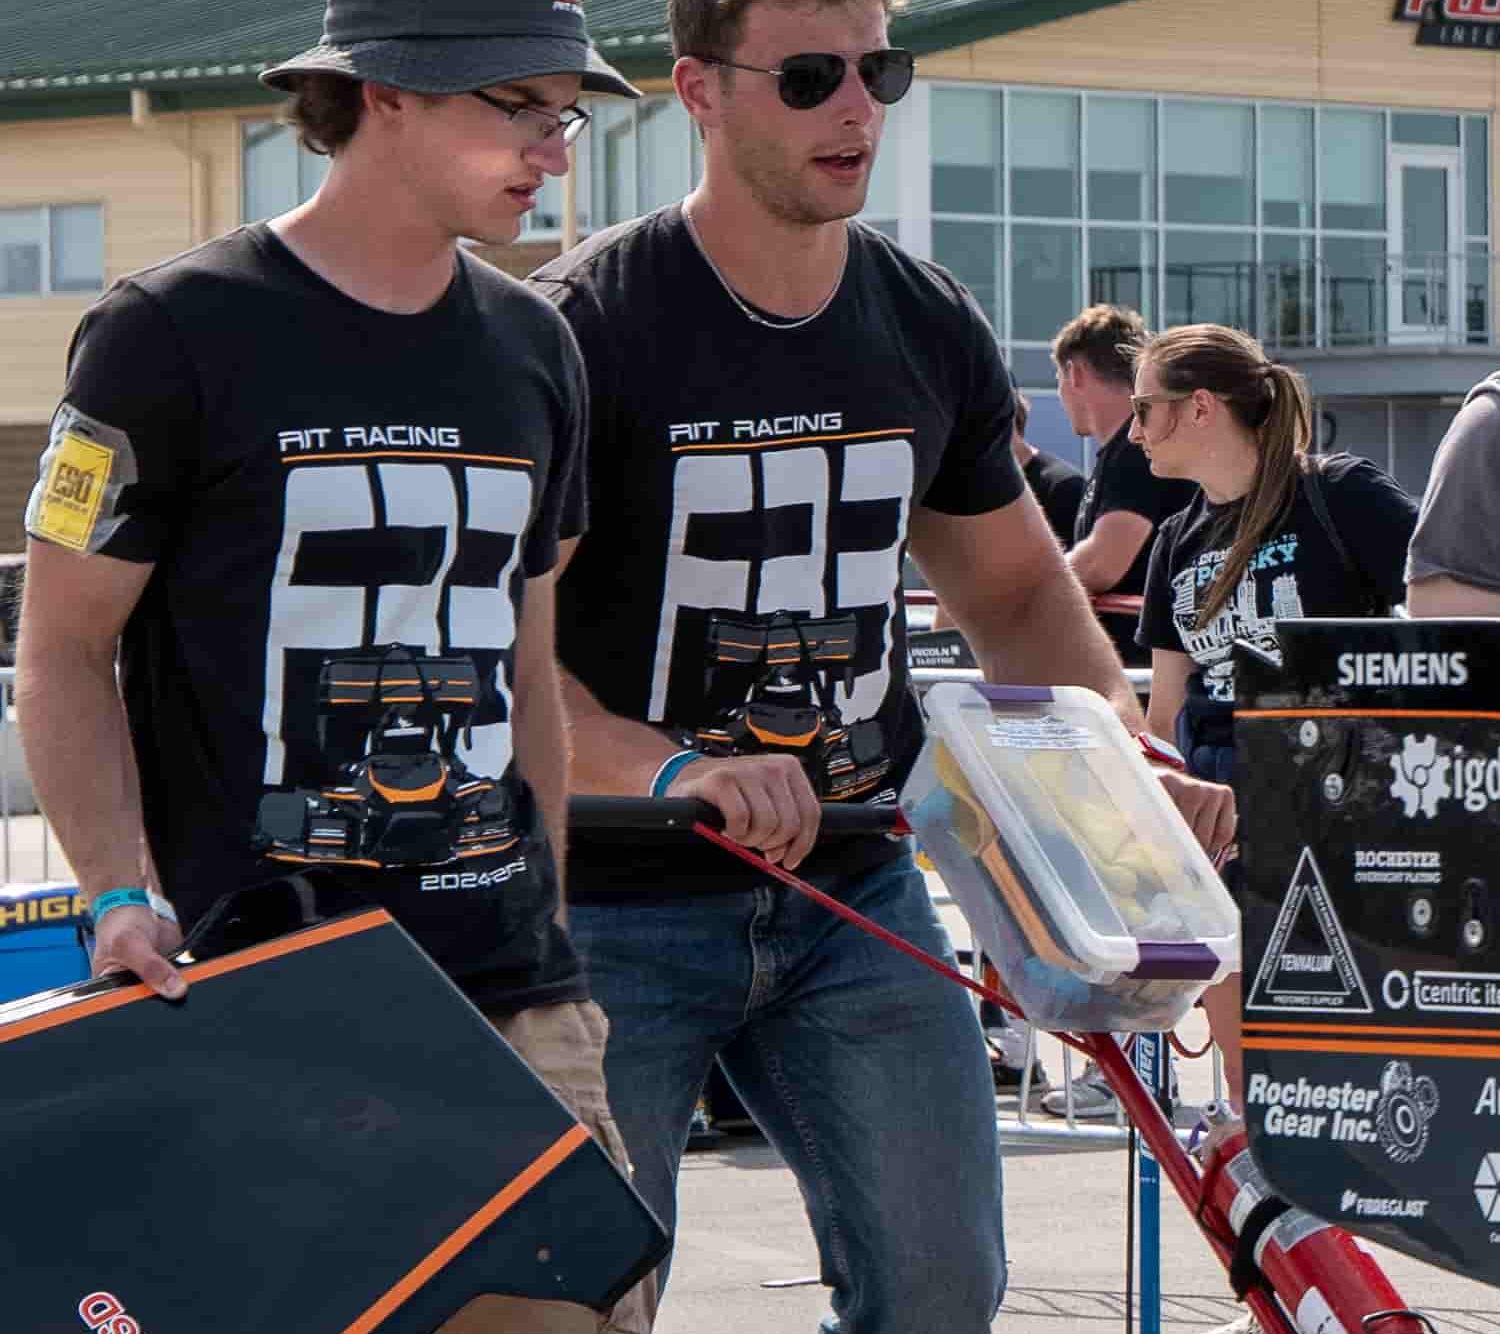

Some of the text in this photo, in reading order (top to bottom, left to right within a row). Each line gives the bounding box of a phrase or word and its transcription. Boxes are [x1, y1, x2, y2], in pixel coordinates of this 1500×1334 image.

[279, 426, 461, 452] RIT RACING
[669, 412, 843, 442] RIT RACING
[1337, 653, 1468, 686] SIEMENS
[1355, 850, 1441, 868] ROCHESTER
[1420, 979, 1482, 1005] centric
[1247, 1073, 1380, 1114] Rochester
[1264, 1109, 1378, 1143] Gear Inc.
